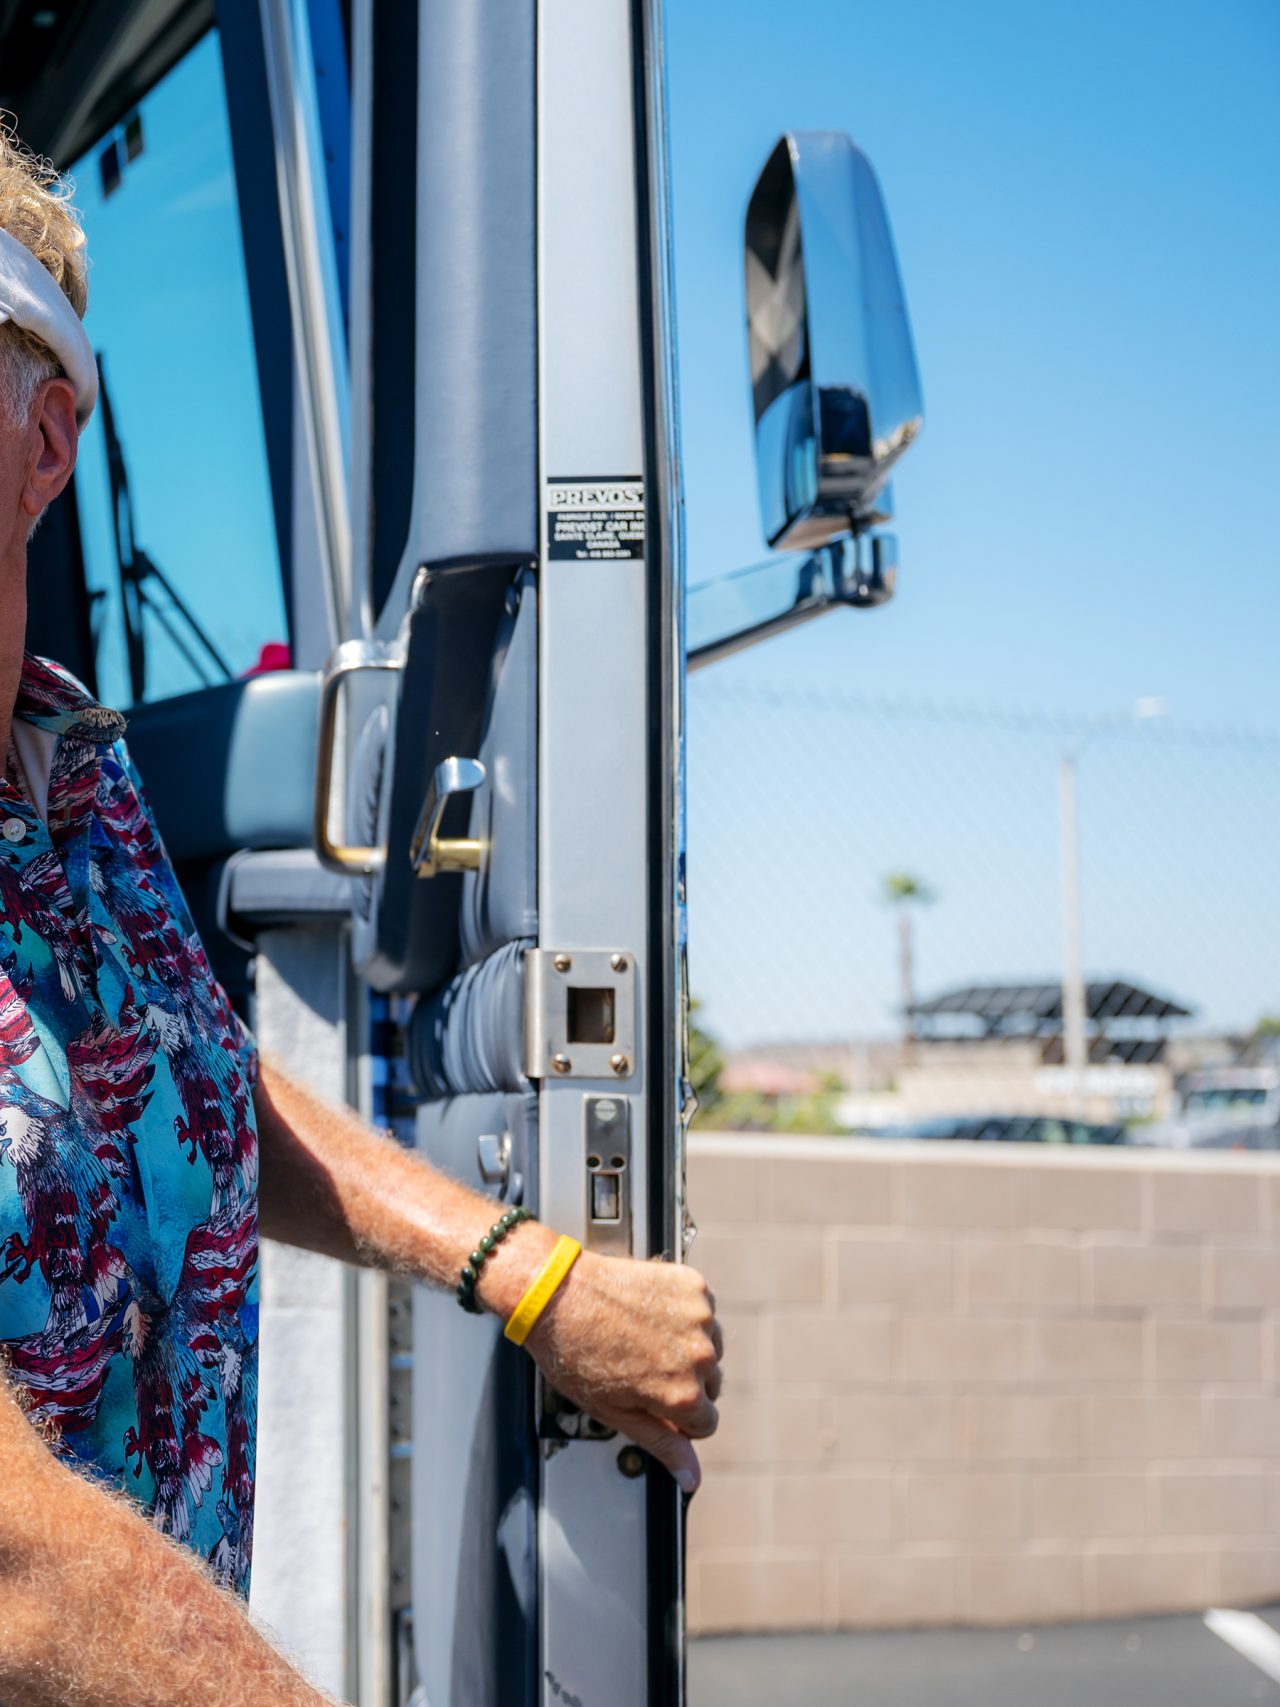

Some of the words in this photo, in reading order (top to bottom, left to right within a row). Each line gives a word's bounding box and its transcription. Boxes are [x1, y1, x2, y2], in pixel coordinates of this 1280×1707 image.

[551, 488, 645, 506] PREVOS
[555, 521, 604, 532] PREVOST
[605, 521, 628, 531] CAR
